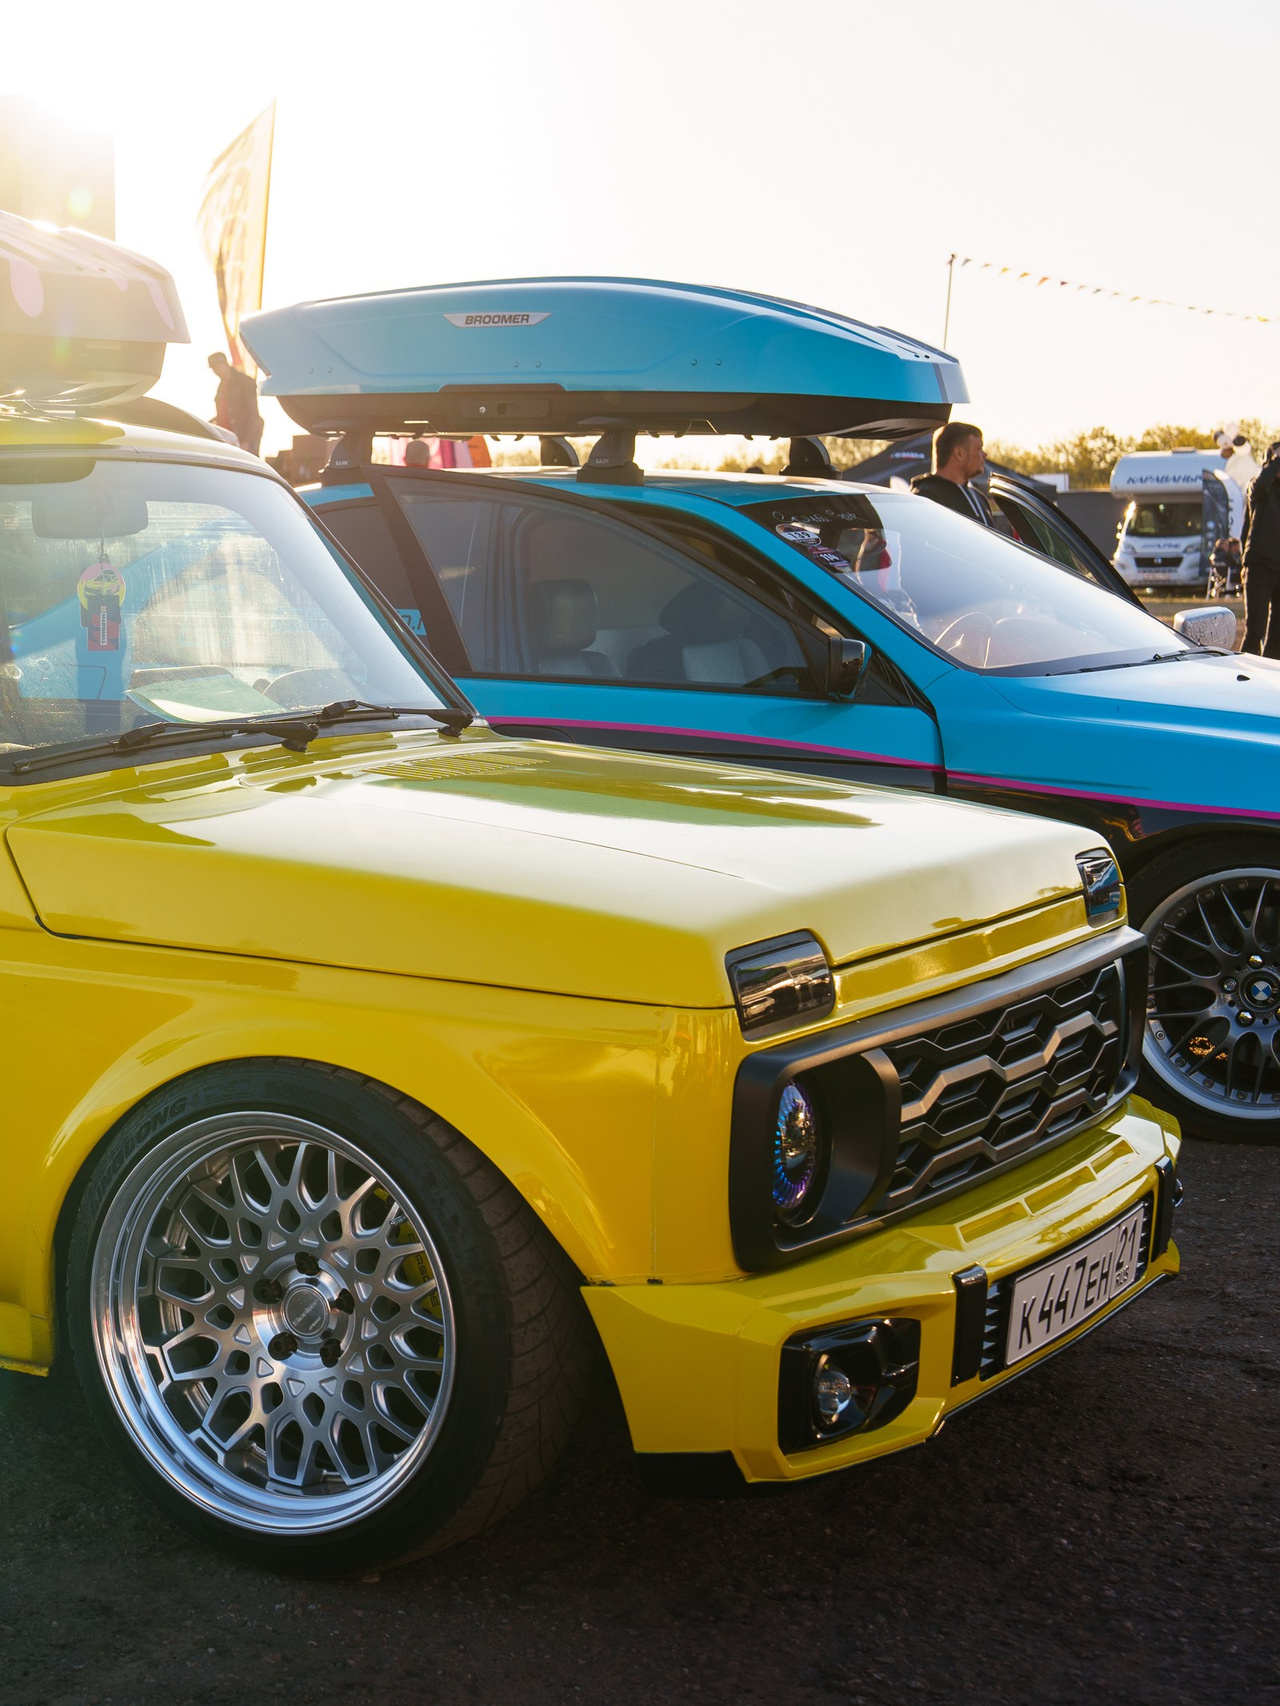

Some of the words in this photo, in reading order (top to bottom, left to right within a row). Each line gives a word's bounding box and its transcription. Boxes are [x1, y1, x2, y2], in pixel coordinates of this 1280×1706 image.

[464, 313, 530, 325] BROOMER
[1115, 1217, 1138, 1272] 21
[1115, 1265, 1130, 1288] RUS
